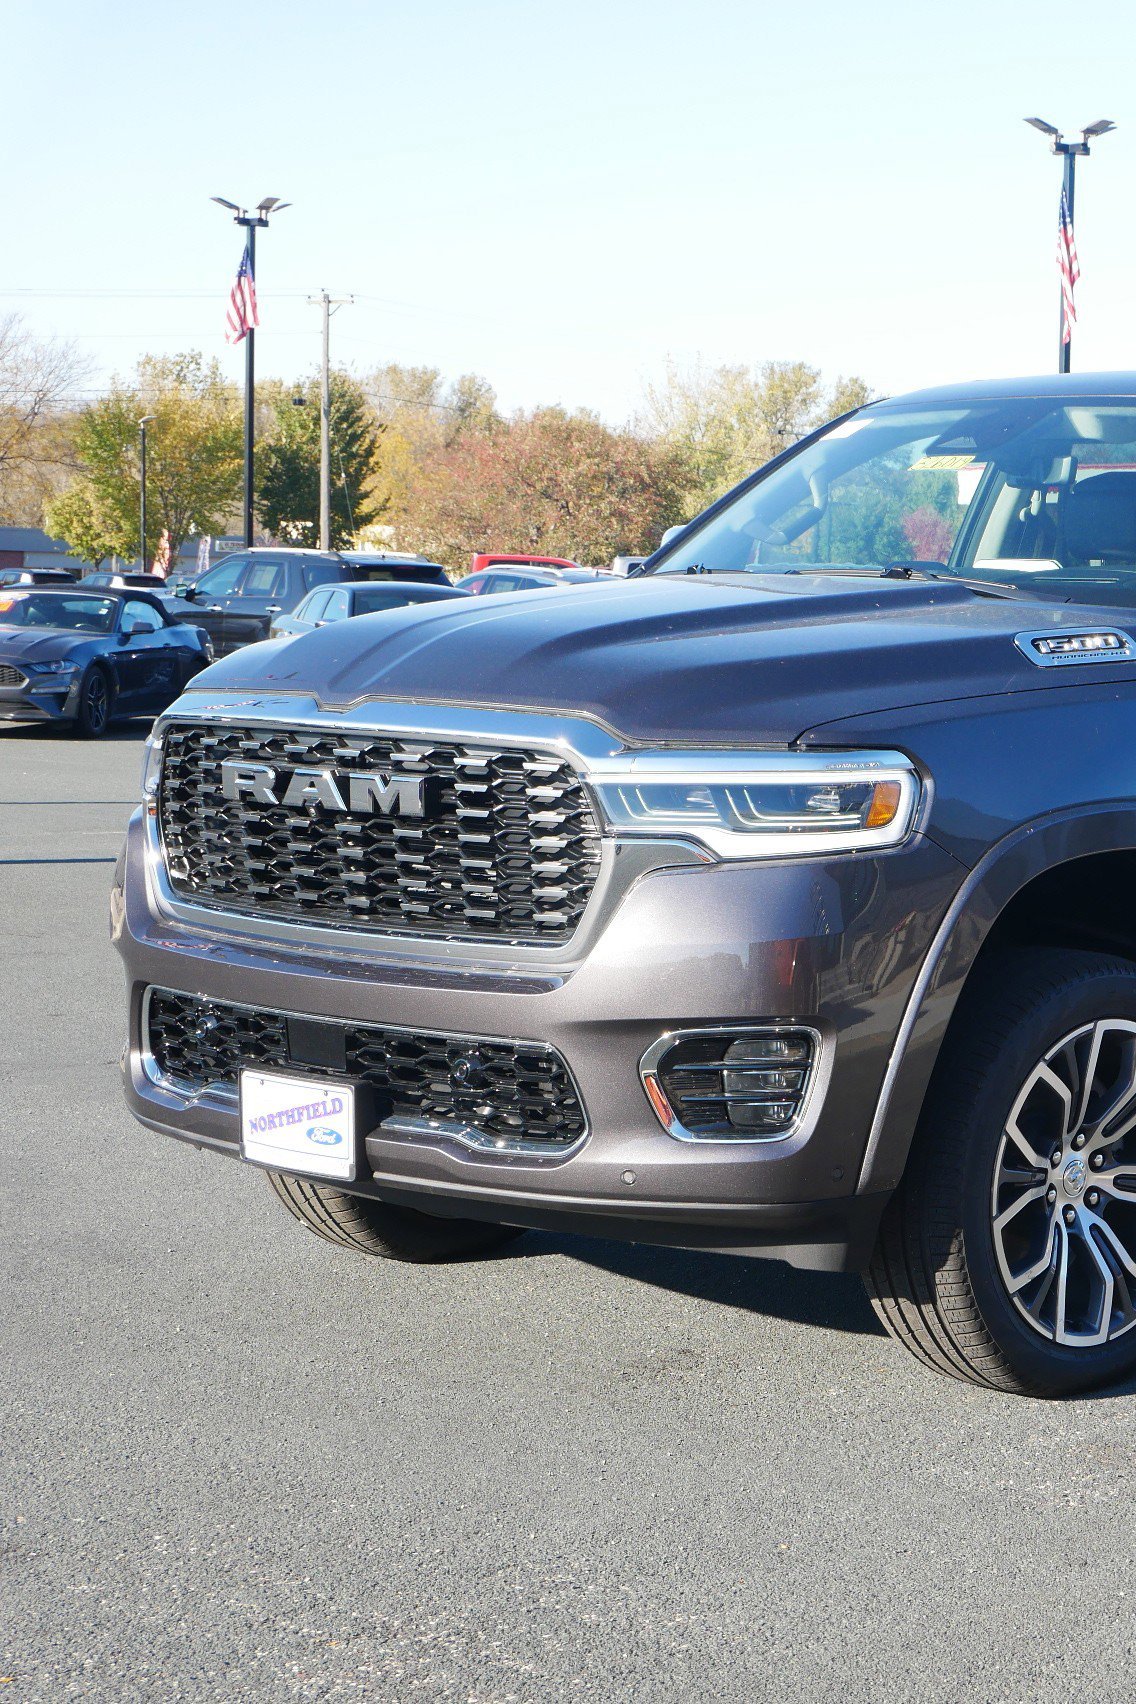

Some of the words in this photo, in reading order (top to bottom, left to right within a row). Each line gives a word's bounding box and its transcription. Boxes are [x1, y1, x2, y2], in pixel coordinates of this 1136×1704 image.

[1033, 634, 1120, 654] 1500
[221, 759, 425, 817] RAM
[248, 1097, 344, 1134] NORTHFIELD
